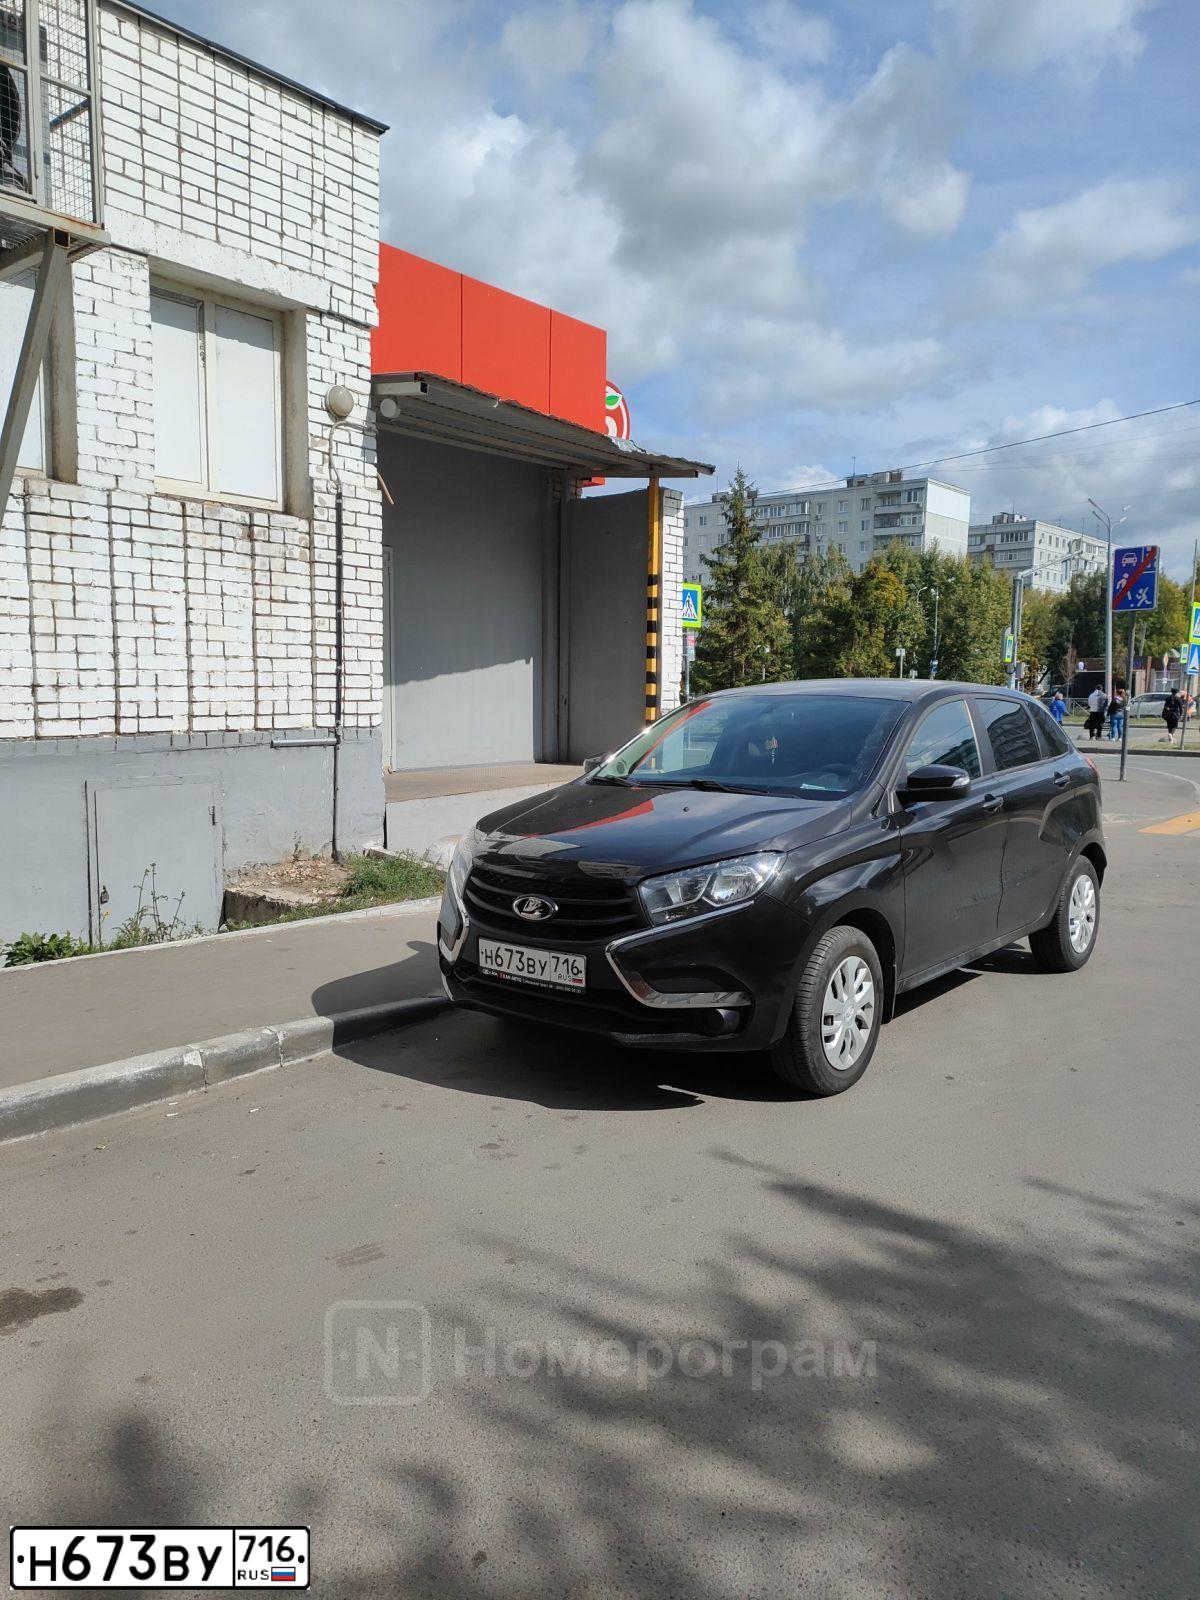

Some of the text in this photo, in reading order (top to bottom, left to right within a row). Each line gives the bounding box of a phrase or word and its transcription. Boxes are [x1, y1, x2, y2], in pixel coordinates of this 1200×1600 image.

[485, 946, 580, 976] Н673ВУ 716
[557, 973, 573, 982] RUS
